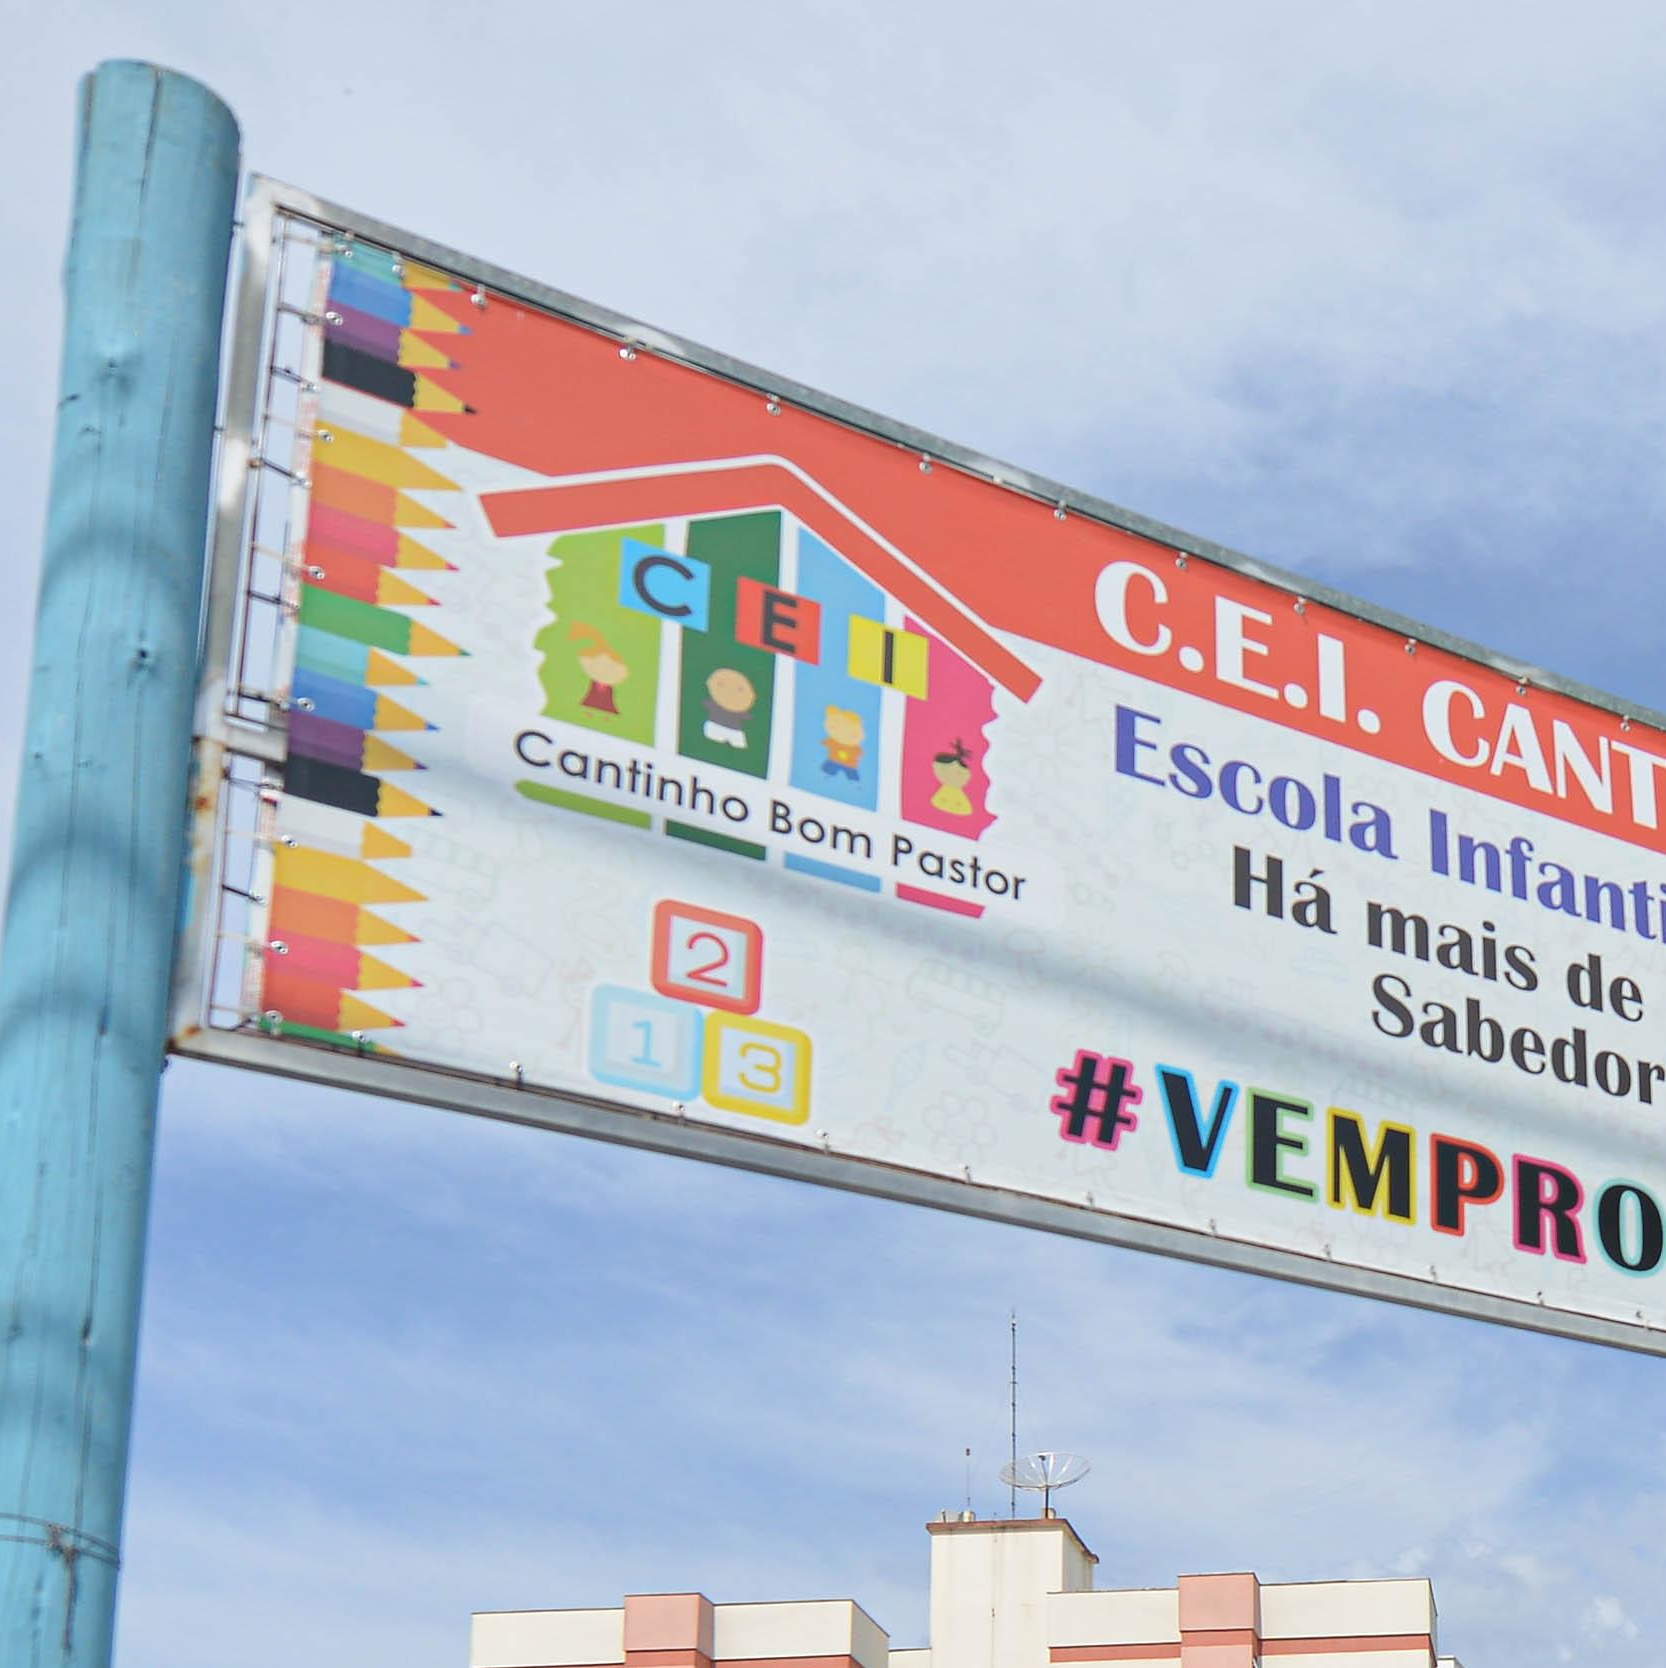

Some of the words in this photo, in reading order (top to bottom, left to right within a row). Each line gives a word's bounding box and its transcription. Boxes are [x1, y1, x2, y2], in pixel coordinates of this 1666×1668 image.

[1094, 560, 1381, 734] C.E.I.
[513, 730, 751, 824] Cantinho
[768, 802, 872, 861] Bom
[892, 834, 1027, 902] Pastor
[1114, 704, 1398, 860] Escola
[685, 933, 729, 987] 2
[1233, 845, 1337, 936] Há
[1367, 899, 1539, 992] mais
[1567, 954, 1644, 1022] de
[631, 1022, 663, 1068] 1
[739, 1044, 782, 1092] 3
